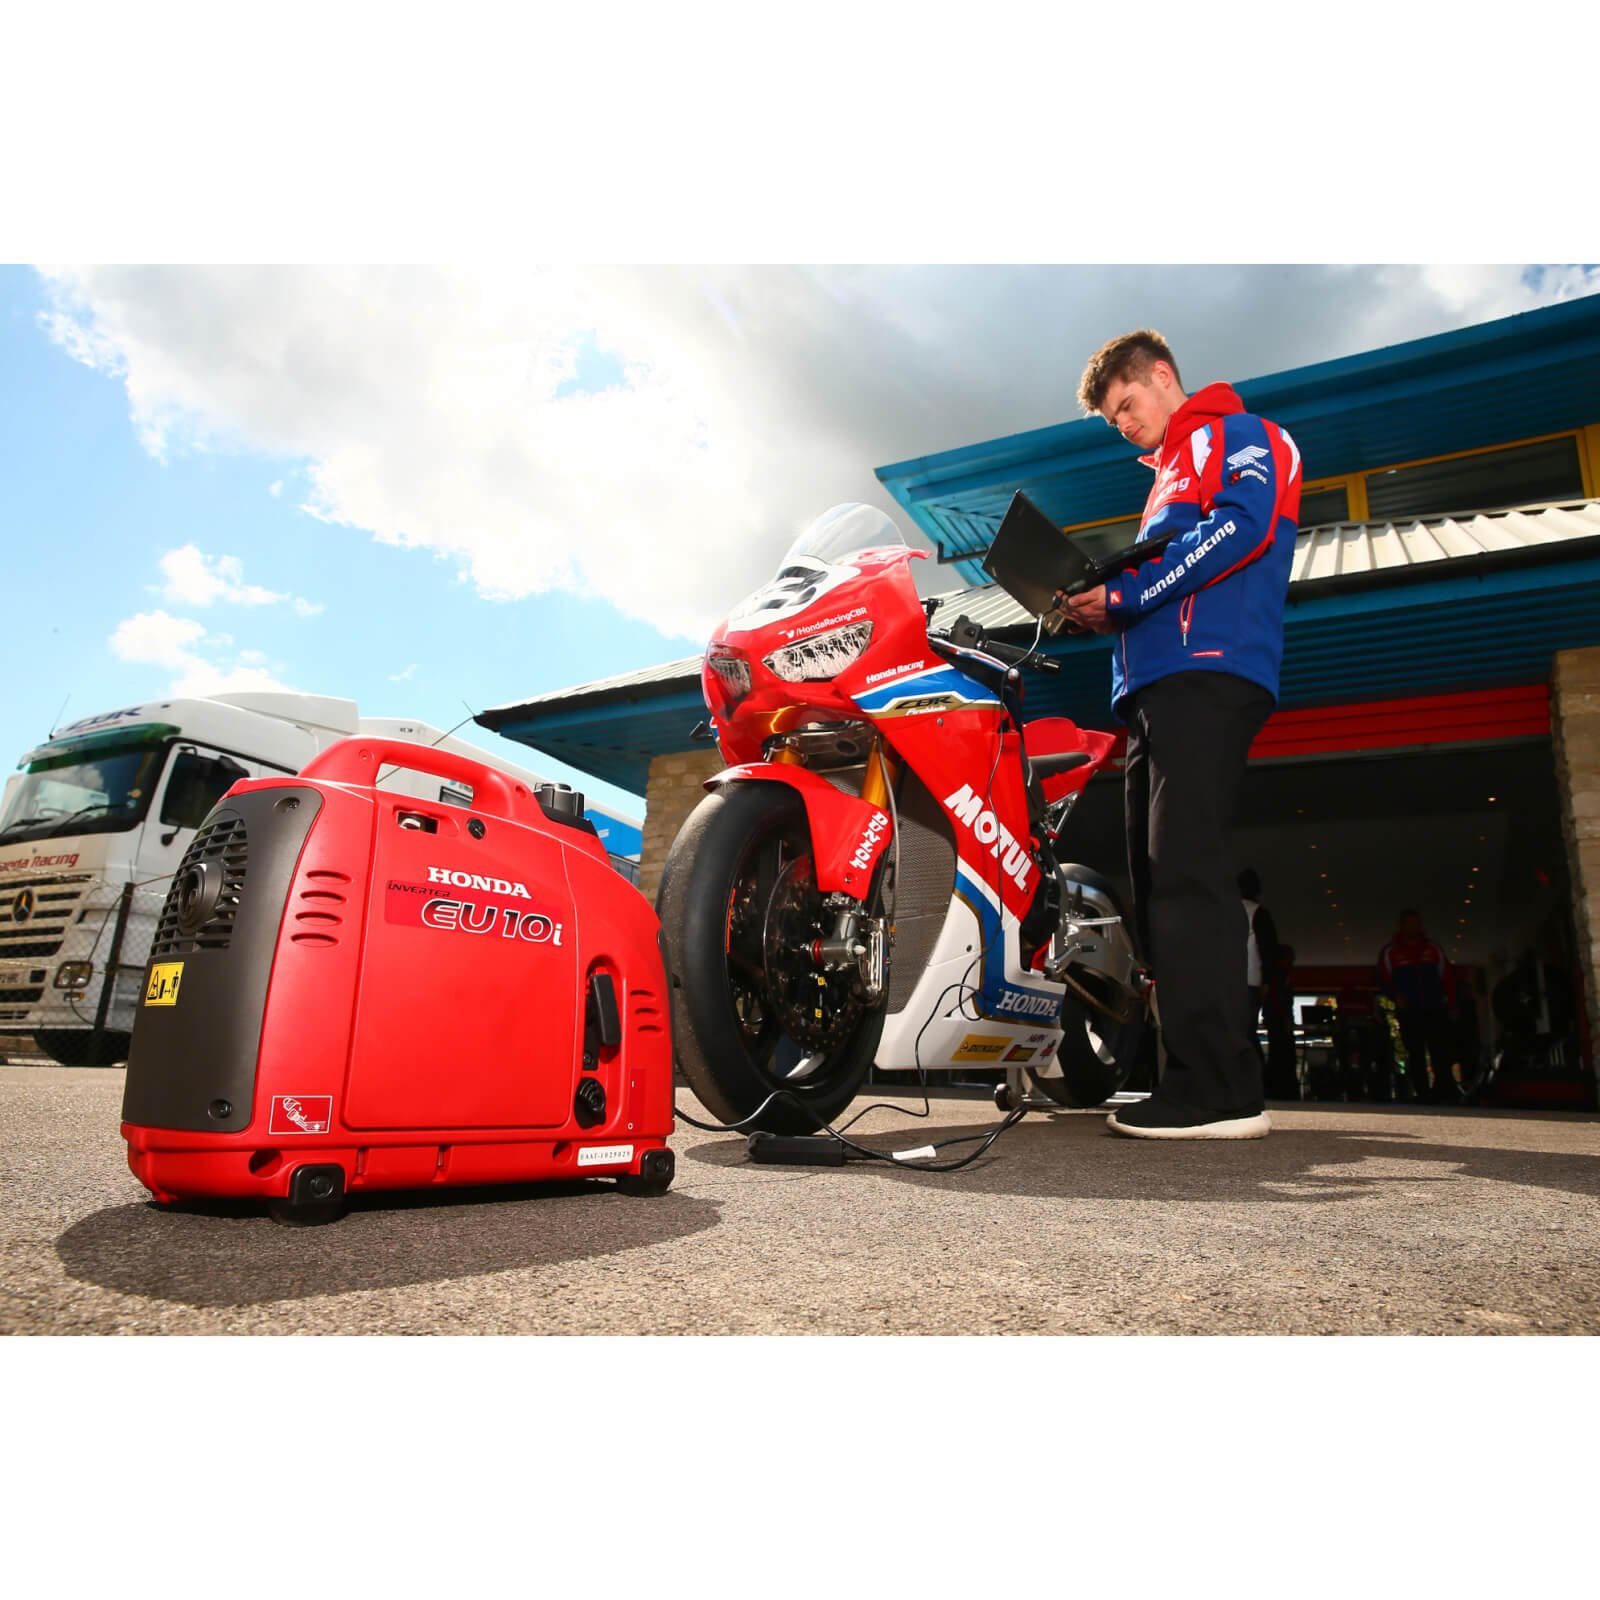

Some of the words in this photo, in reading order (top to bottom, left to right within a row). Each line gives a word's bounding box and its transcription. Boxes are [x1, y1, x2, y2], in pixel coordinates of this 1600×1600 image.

[1140, 564, 1186, 605] Honda
[1184, 520, 1237, 568] Racing
[866, 667, 897, 684] Honda
[897, 660, 925, 674] Racing
[943, 783, 1033, 891] MOTUL
[31, 853, 80, 868] Racing
[427, 866, 532, 899] HONDA
[999, 990, 1059, 1017] HONDA
